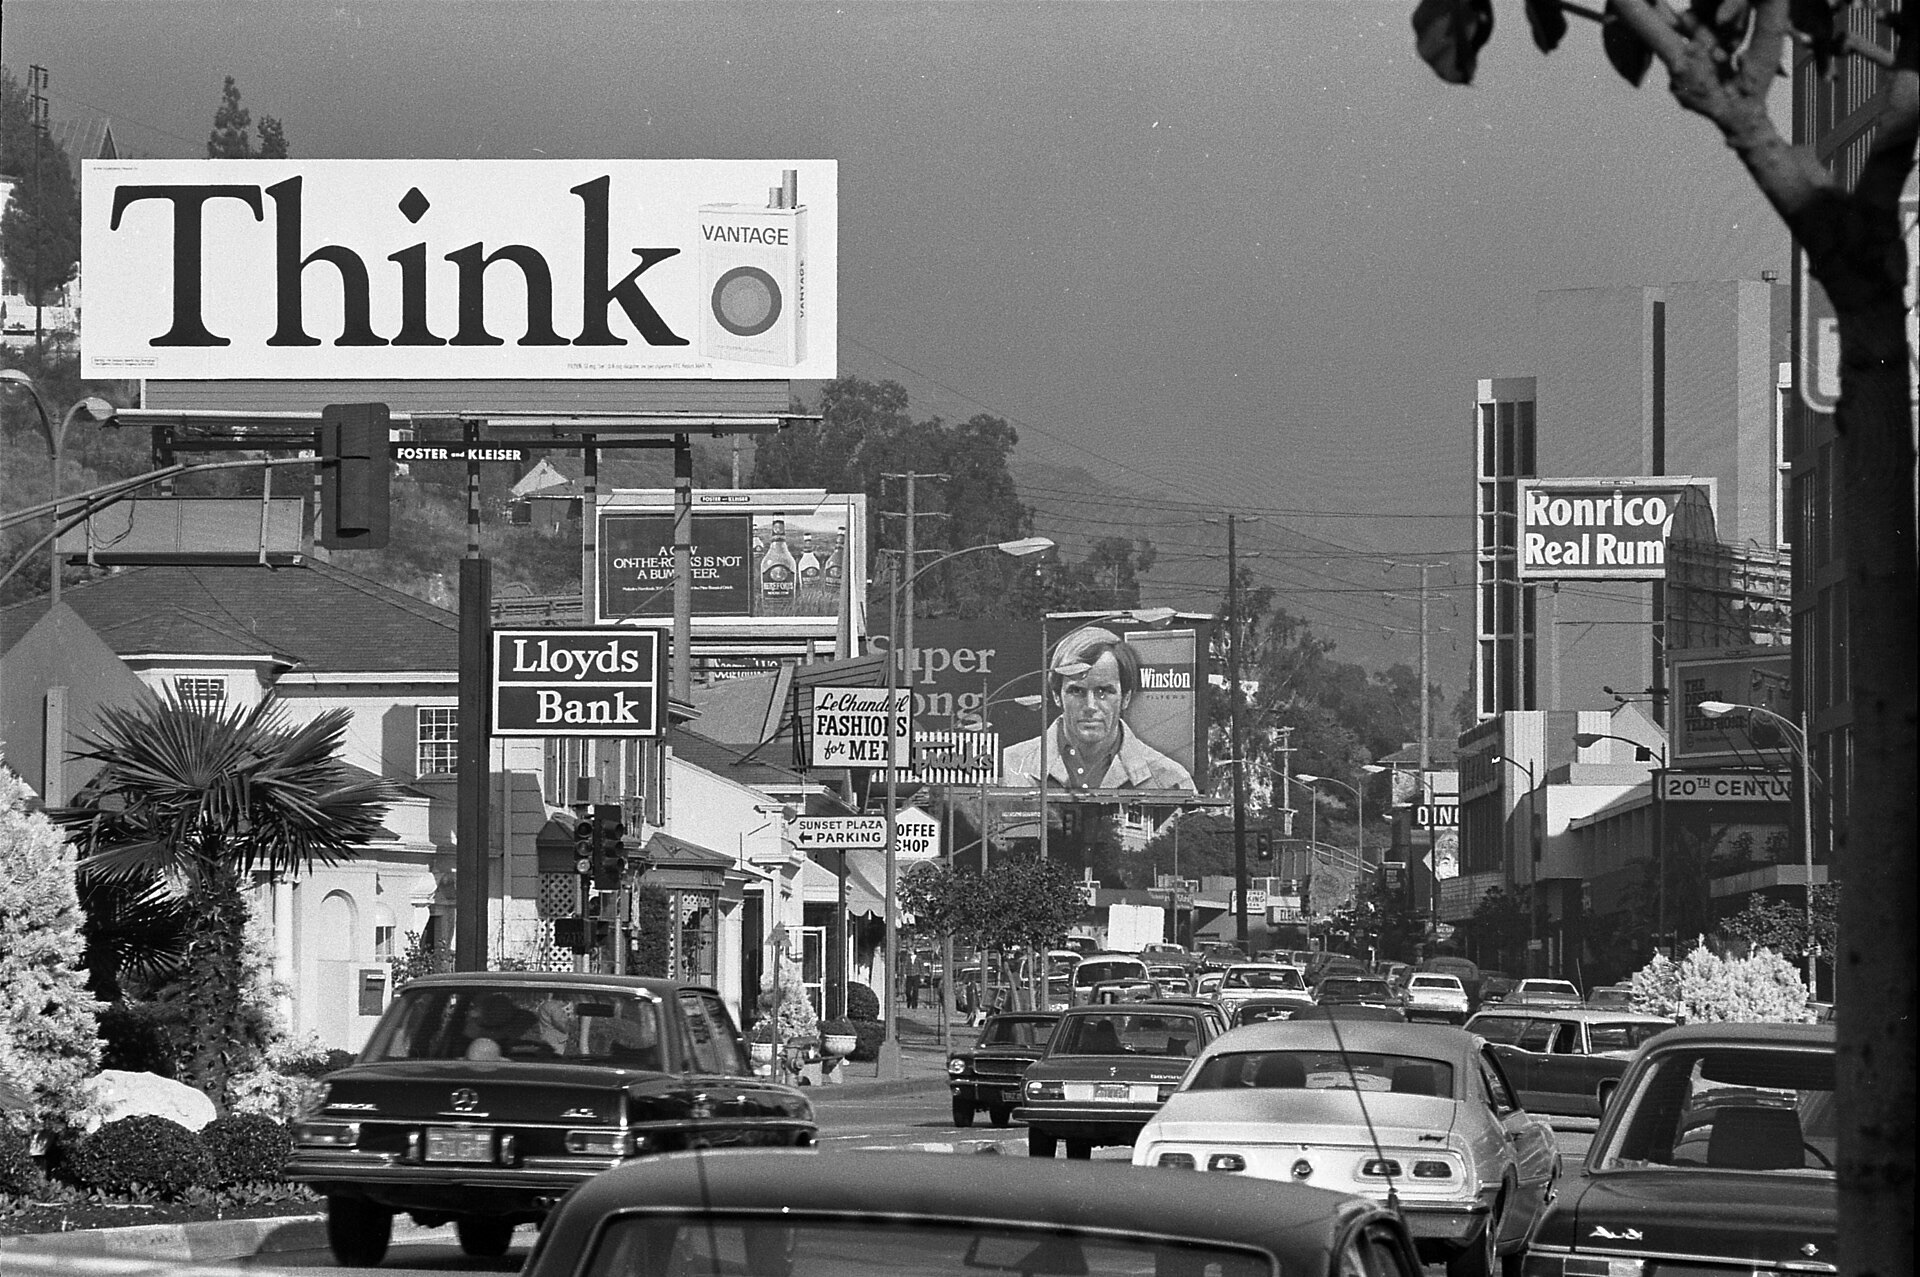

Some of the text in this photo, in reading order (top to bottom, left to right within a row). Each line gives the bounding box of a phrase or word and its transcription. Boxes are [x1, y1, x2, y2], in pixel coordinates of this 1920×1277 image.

[702, 224, 788, 246] VANTAGE
[110, 176, 689, 346] Think
[397, 448, 448, 460] FOSTER
[468, 449, 521, 460] KLEISER
[1526, 490, 1667, 526] Ronrico
[658, 546, 668, 556] A
[1526, 533, 1664, 565] Real Rum
[703, 556, 714, 567] IS
[716, 556, 743, 567] NOT
[637, 570, 647, 580] A
[512, 639, 639, 680] Lloyds
[1140, 668, 1191, 689] Winston
[536, 690, 639, 724] Bank
[824, 740, 846, 760] for
[799, 820, 883, 830] SUNSET PLAZA
[896, 824, 936, 837] OFFEE
[816, 832, 881, 843] PARKING
